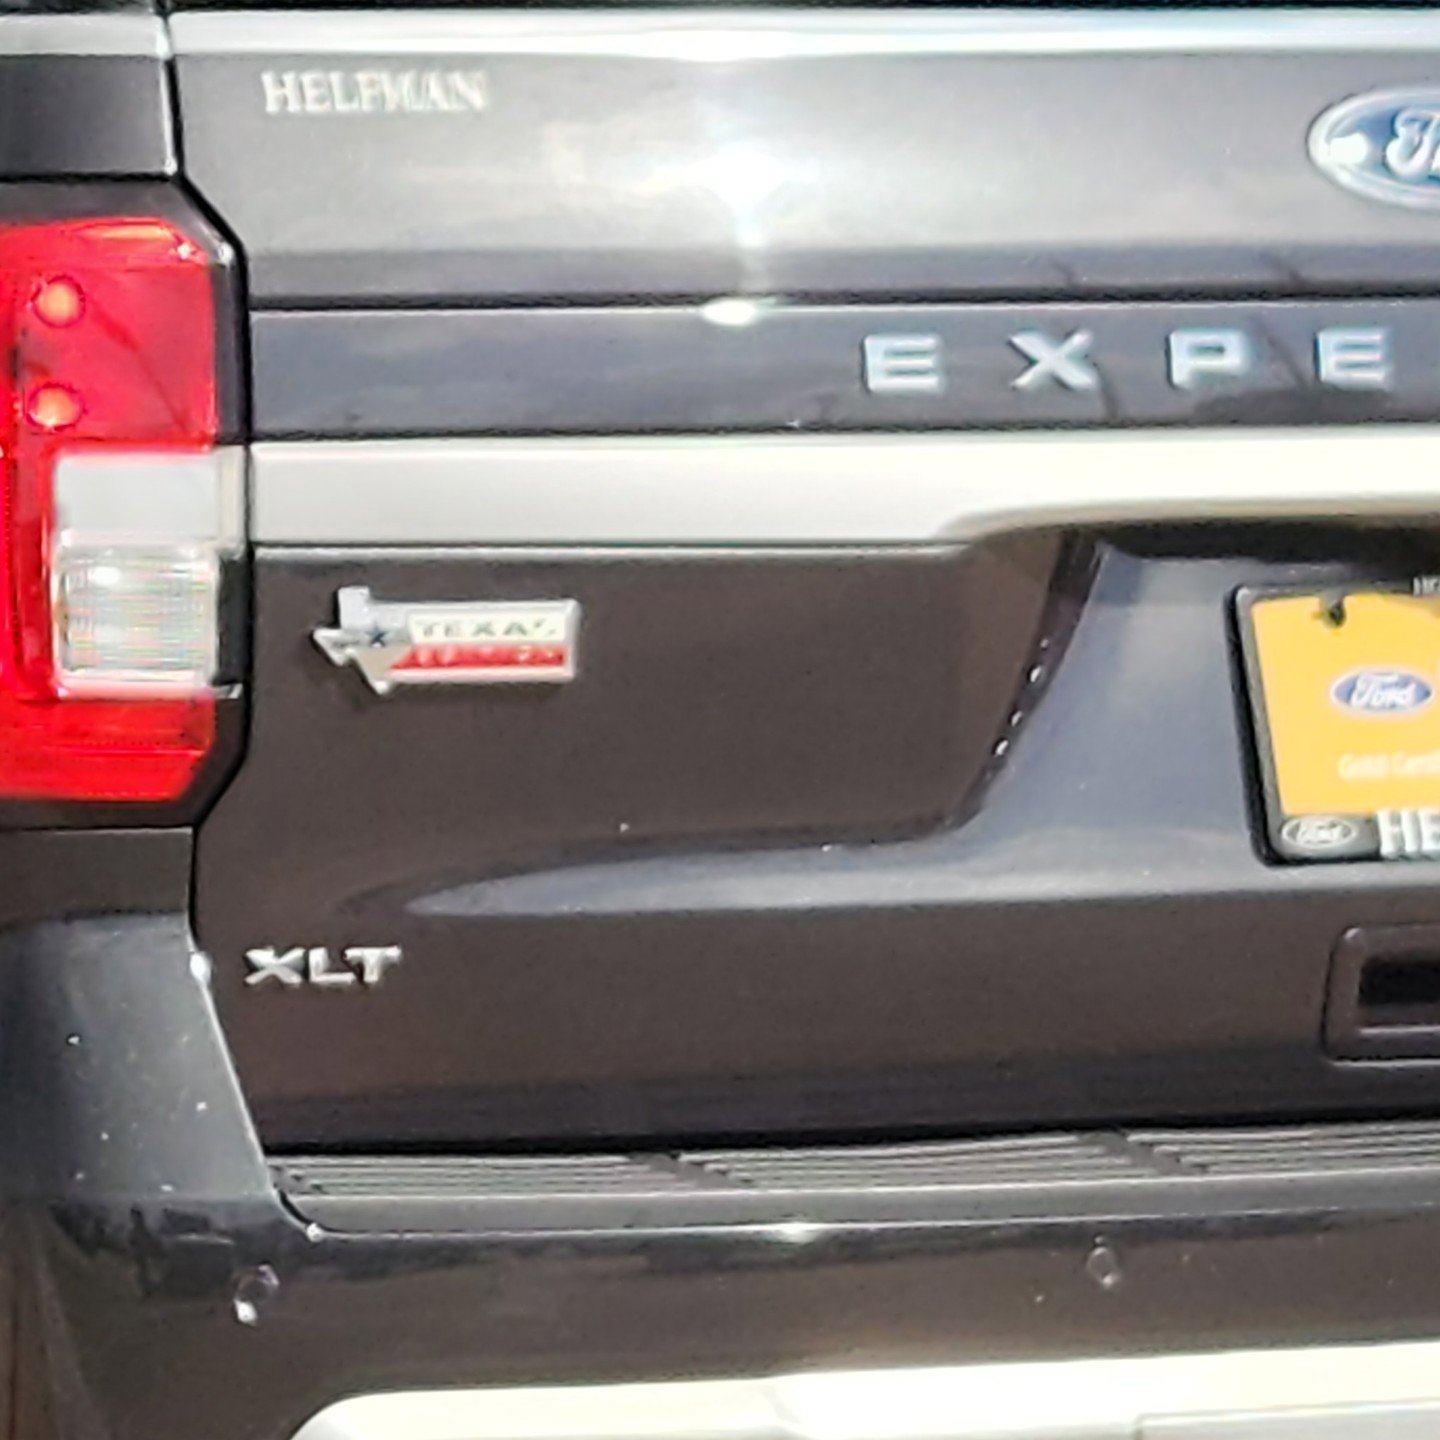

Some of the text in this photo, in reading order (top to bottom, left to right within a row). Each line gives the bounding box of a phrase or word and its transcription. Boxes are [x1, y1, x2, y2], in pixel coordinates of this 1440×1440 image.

[261, 70, 487, 113] HELFMAN
[418, 616, 559, 639] TEXAS
[1347, 670, 1417, 710] Ford
[245, 945, 402, 984] XLT
